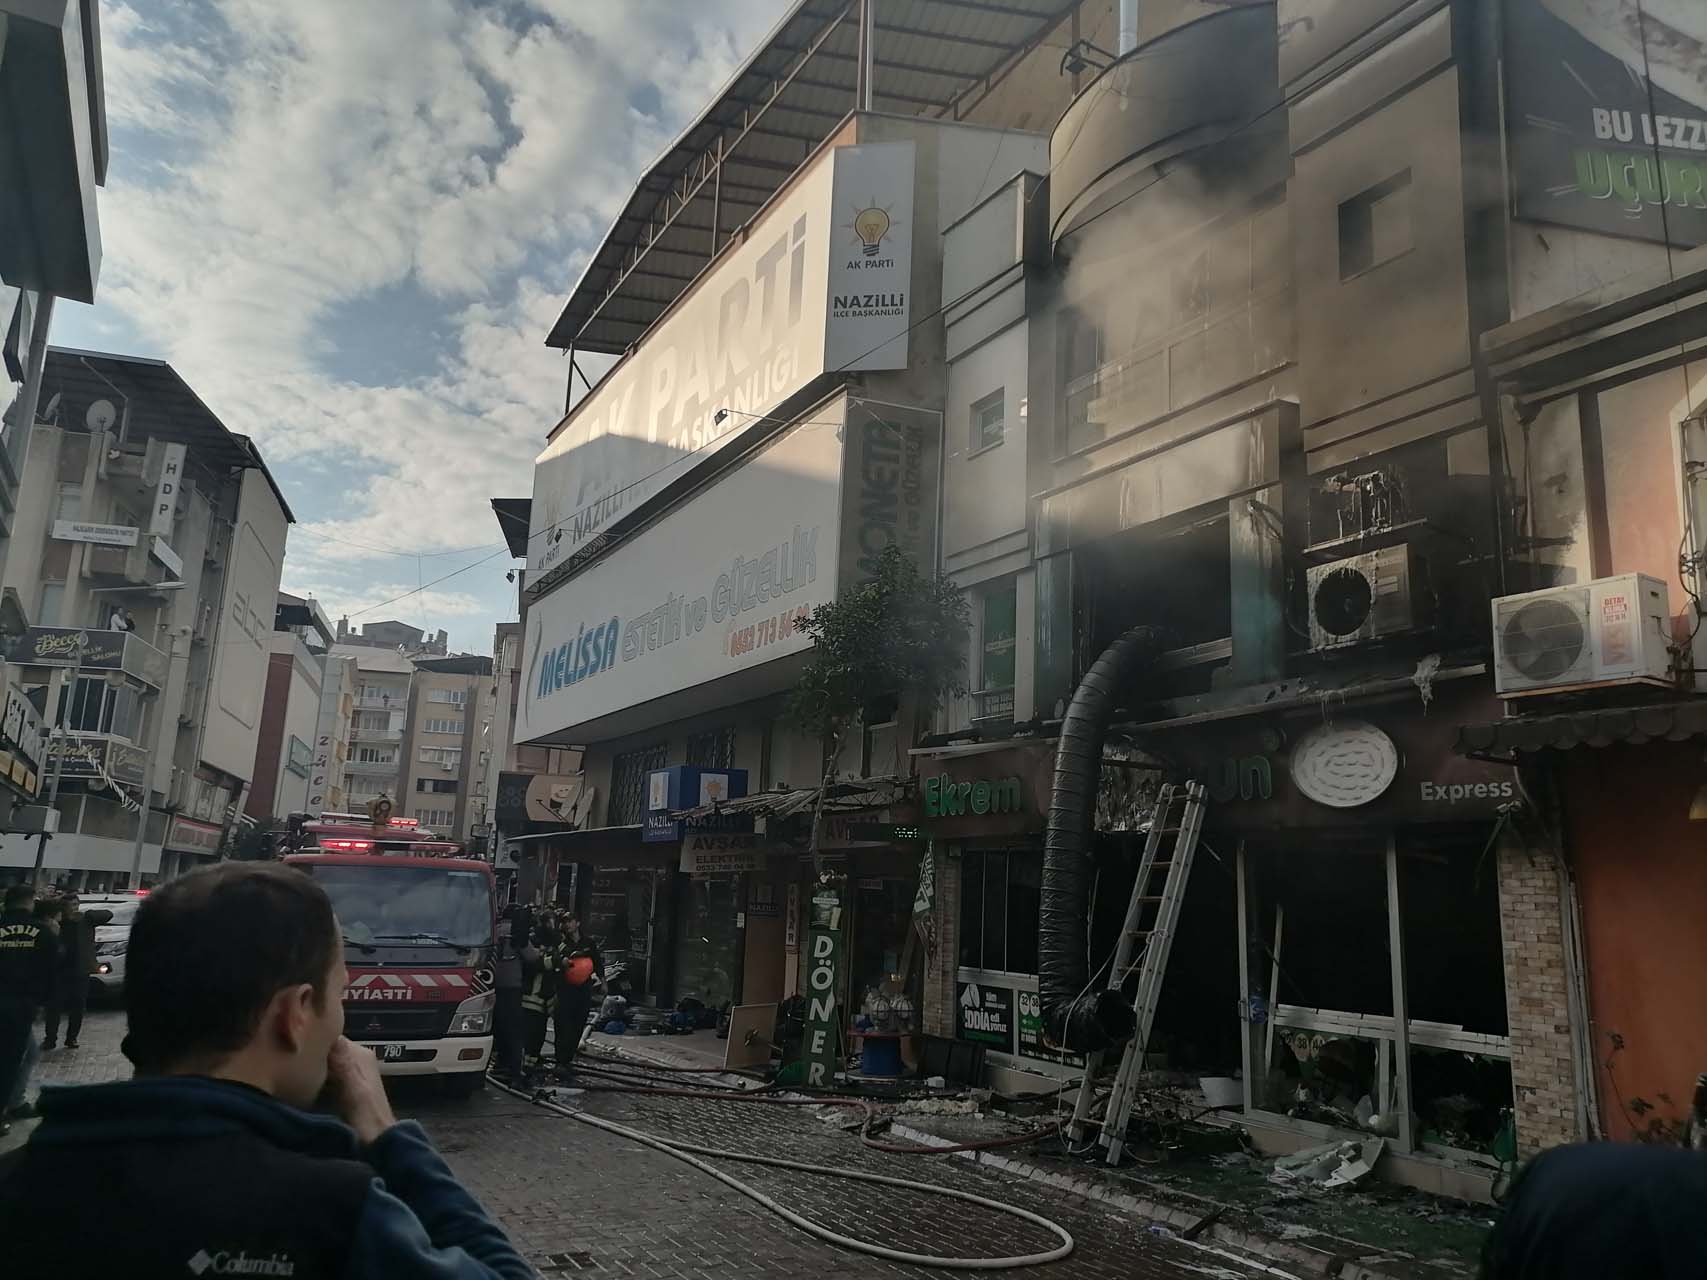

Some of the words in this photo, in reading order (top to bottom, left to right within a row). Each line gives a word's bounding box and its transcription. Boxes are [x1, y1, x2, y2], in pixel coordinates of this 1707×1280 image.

[1592, 107, 1633, 142] BU
[1641, 113, 1707, 150] LEZZ
[846, 260, 861, 269] AK
[865, 258, 894, 269] PARTİ
[158, 463, 178, 515] HDP
[537, 615, 620, 701] MELİSSA
[925, 771, 1022, 817] Ekrem
[1420, 781, 1513, 805] Express
[808, 935, 835, 1087] DÖNER
[383, 1044, 402, 1058] 790
[211, 1250, 295, 1277] Columbia
